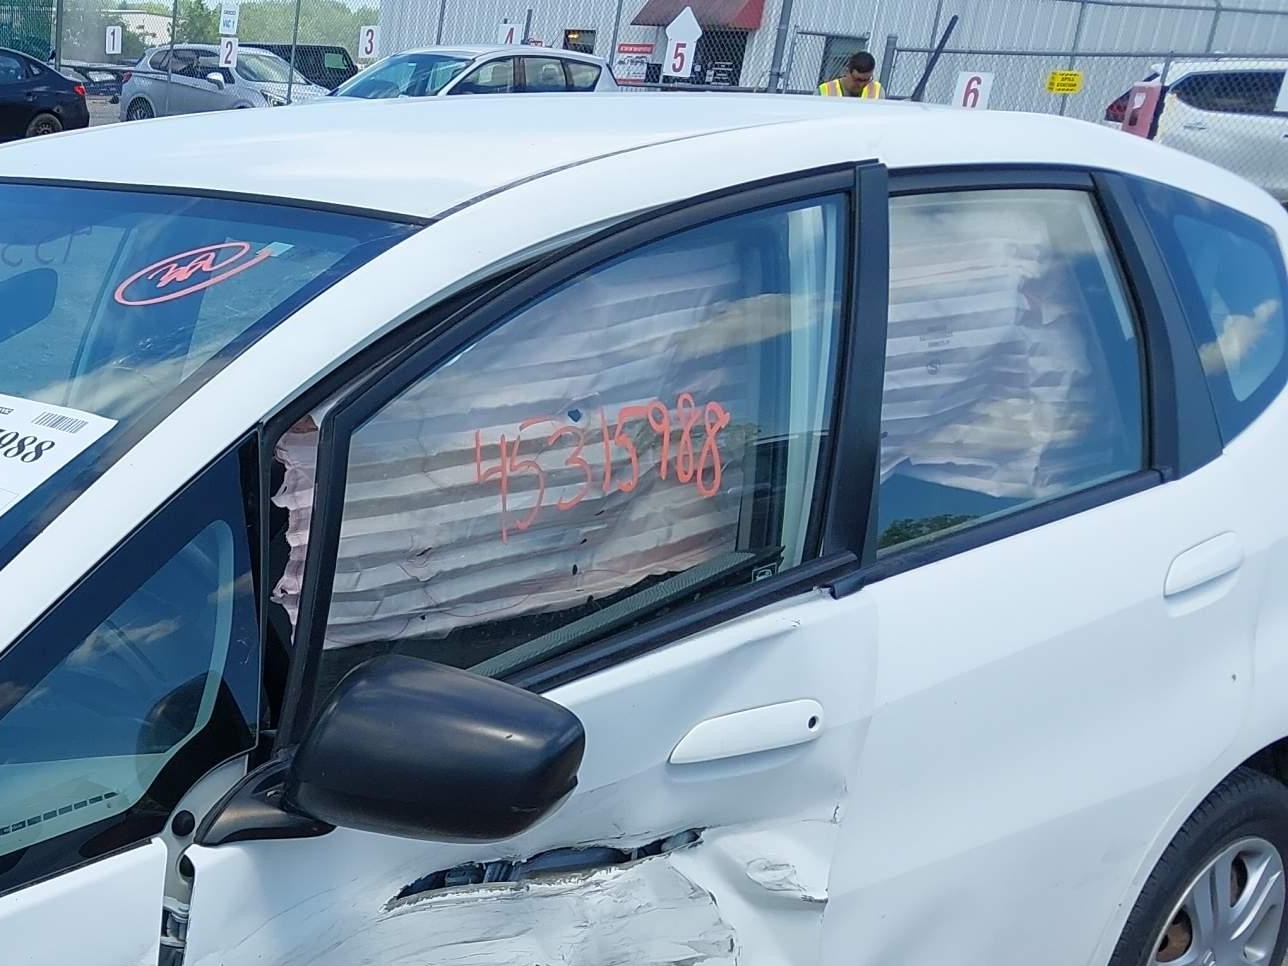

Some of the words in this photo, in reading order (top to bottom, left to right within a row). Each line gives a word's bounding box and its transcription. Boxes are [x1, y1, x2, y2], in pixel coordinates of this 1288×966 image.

[224, 41, 233, 65] 2
[364, 28, 375, 55] 3
[672, 42, 687, 73] 5
[962, 76, 982, 108] 6
[473, 391, 731, 544] 45315988
